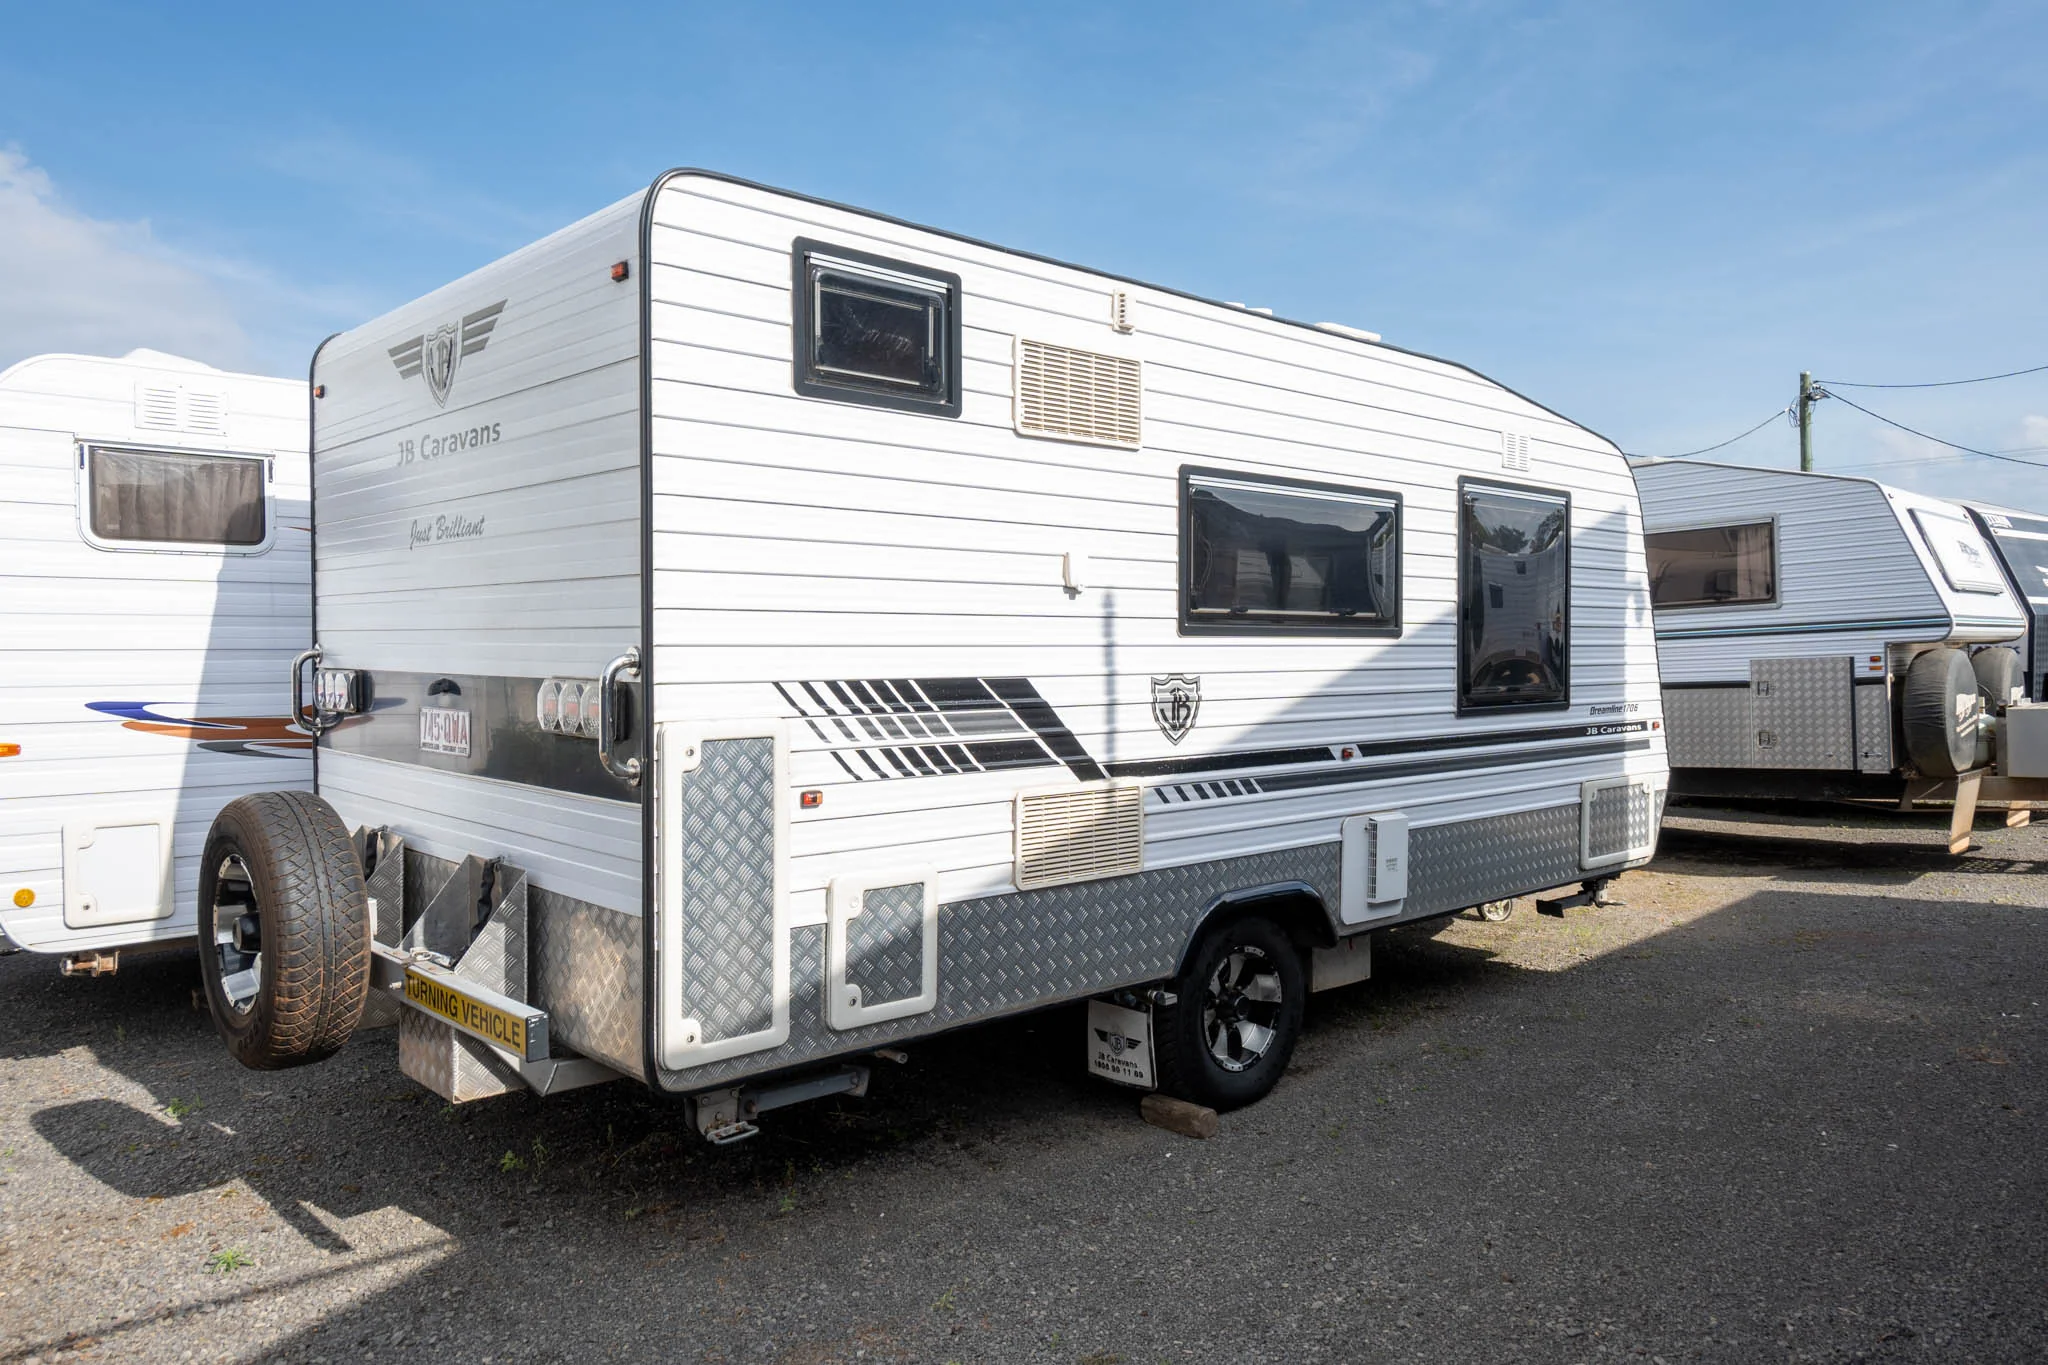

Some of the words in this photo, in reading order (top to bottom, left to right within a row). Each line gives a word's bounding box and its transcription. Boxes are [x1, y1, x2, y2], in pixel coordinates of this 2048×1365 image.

[398, 438, 415, 467] JB
[421, 422, 502, 461] Caravans
[410, 519, 432, 551] Just
[436, 514, 485, 541] Brilliant
[1589, 704, 1624, 716] Dreamline
[1585, 727, 1599, 736] JB
[1600, 723, 1642, 734] Caravans
[405, 973, 459, 1019] TURNING
[461, 999, 521, 1049] VEHICLE
[1106, 1054, 1138, 1069] Caravans
